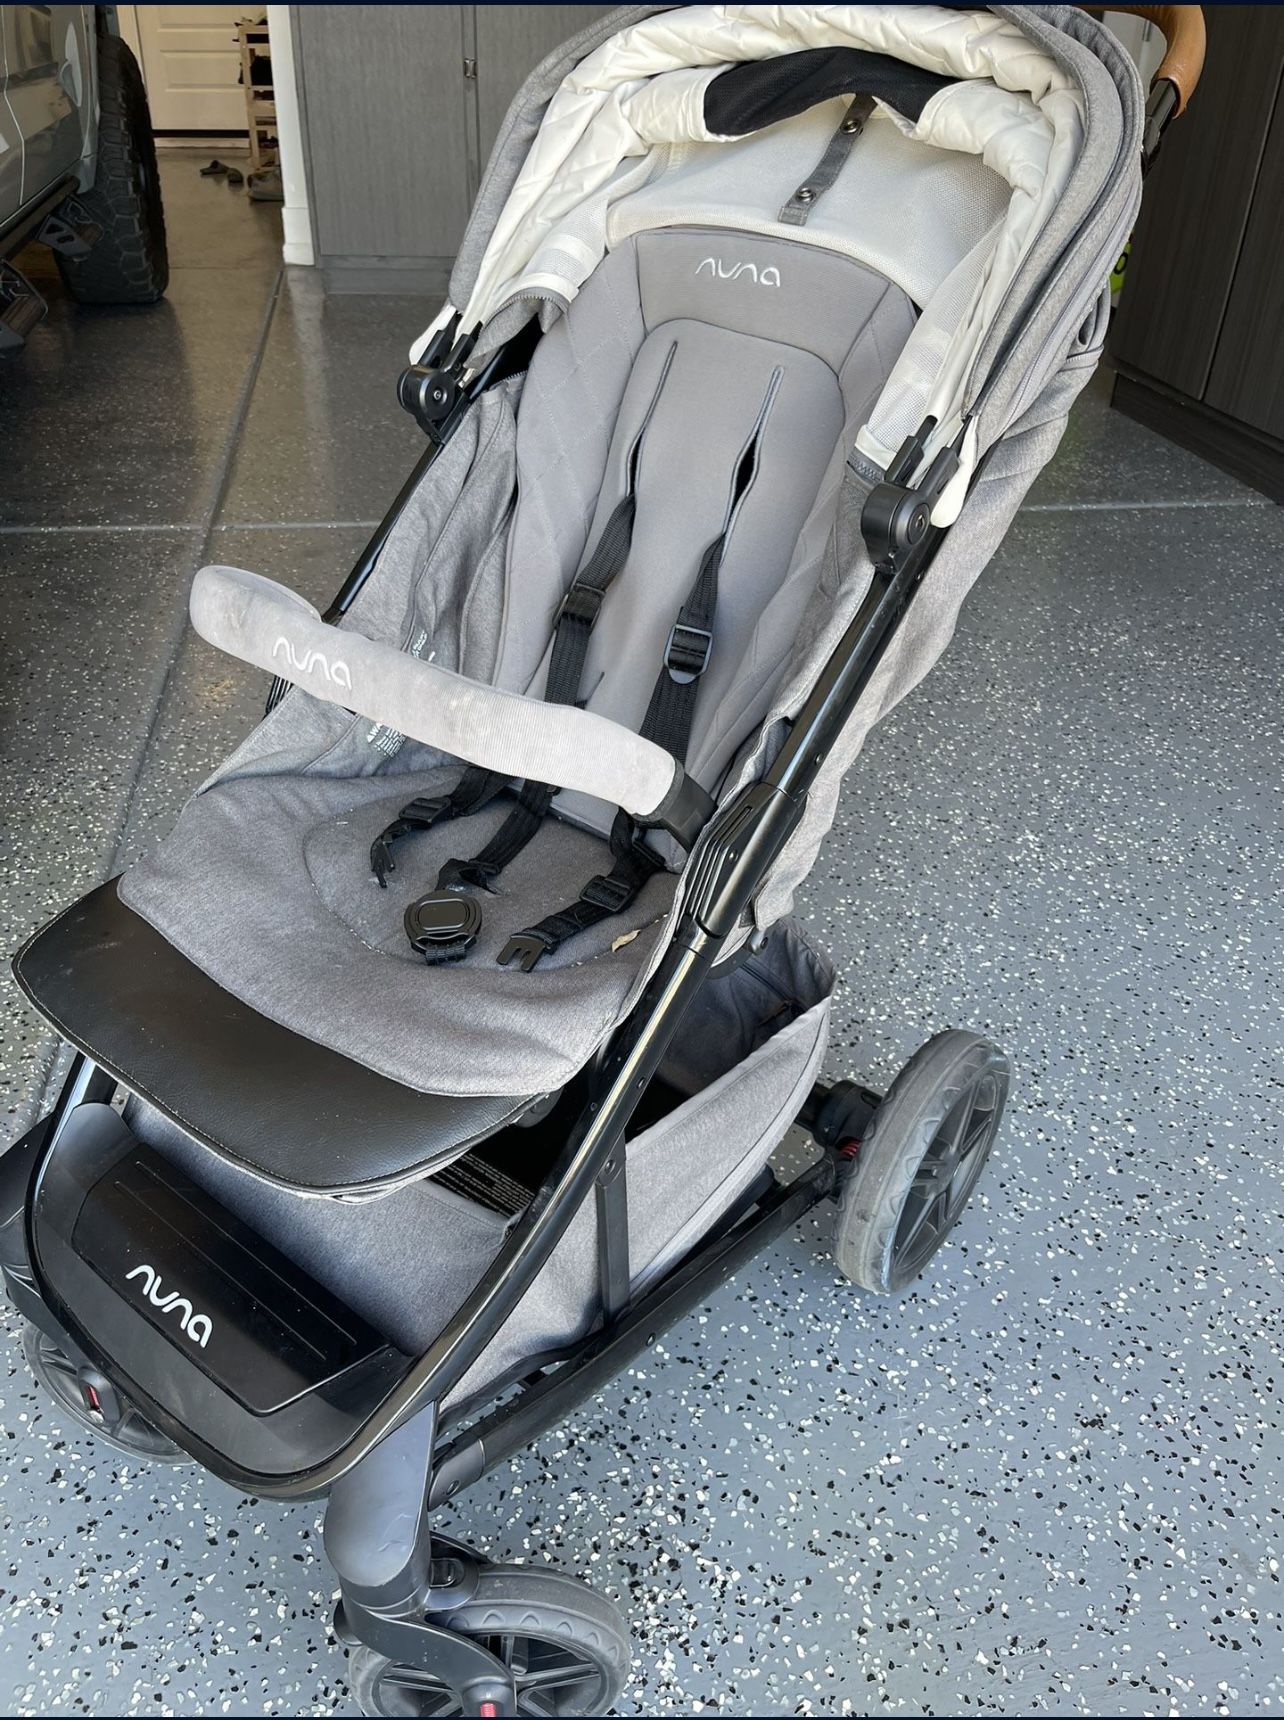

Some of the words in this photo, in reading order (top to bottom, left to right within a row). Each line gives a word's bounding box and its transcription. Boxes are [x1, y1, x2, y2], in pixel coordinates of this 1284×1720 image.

[695, 257, 780, 287] nuna
[273, 636, 352, 690] nuna
[125, 1264, 213, 1348] nuna
